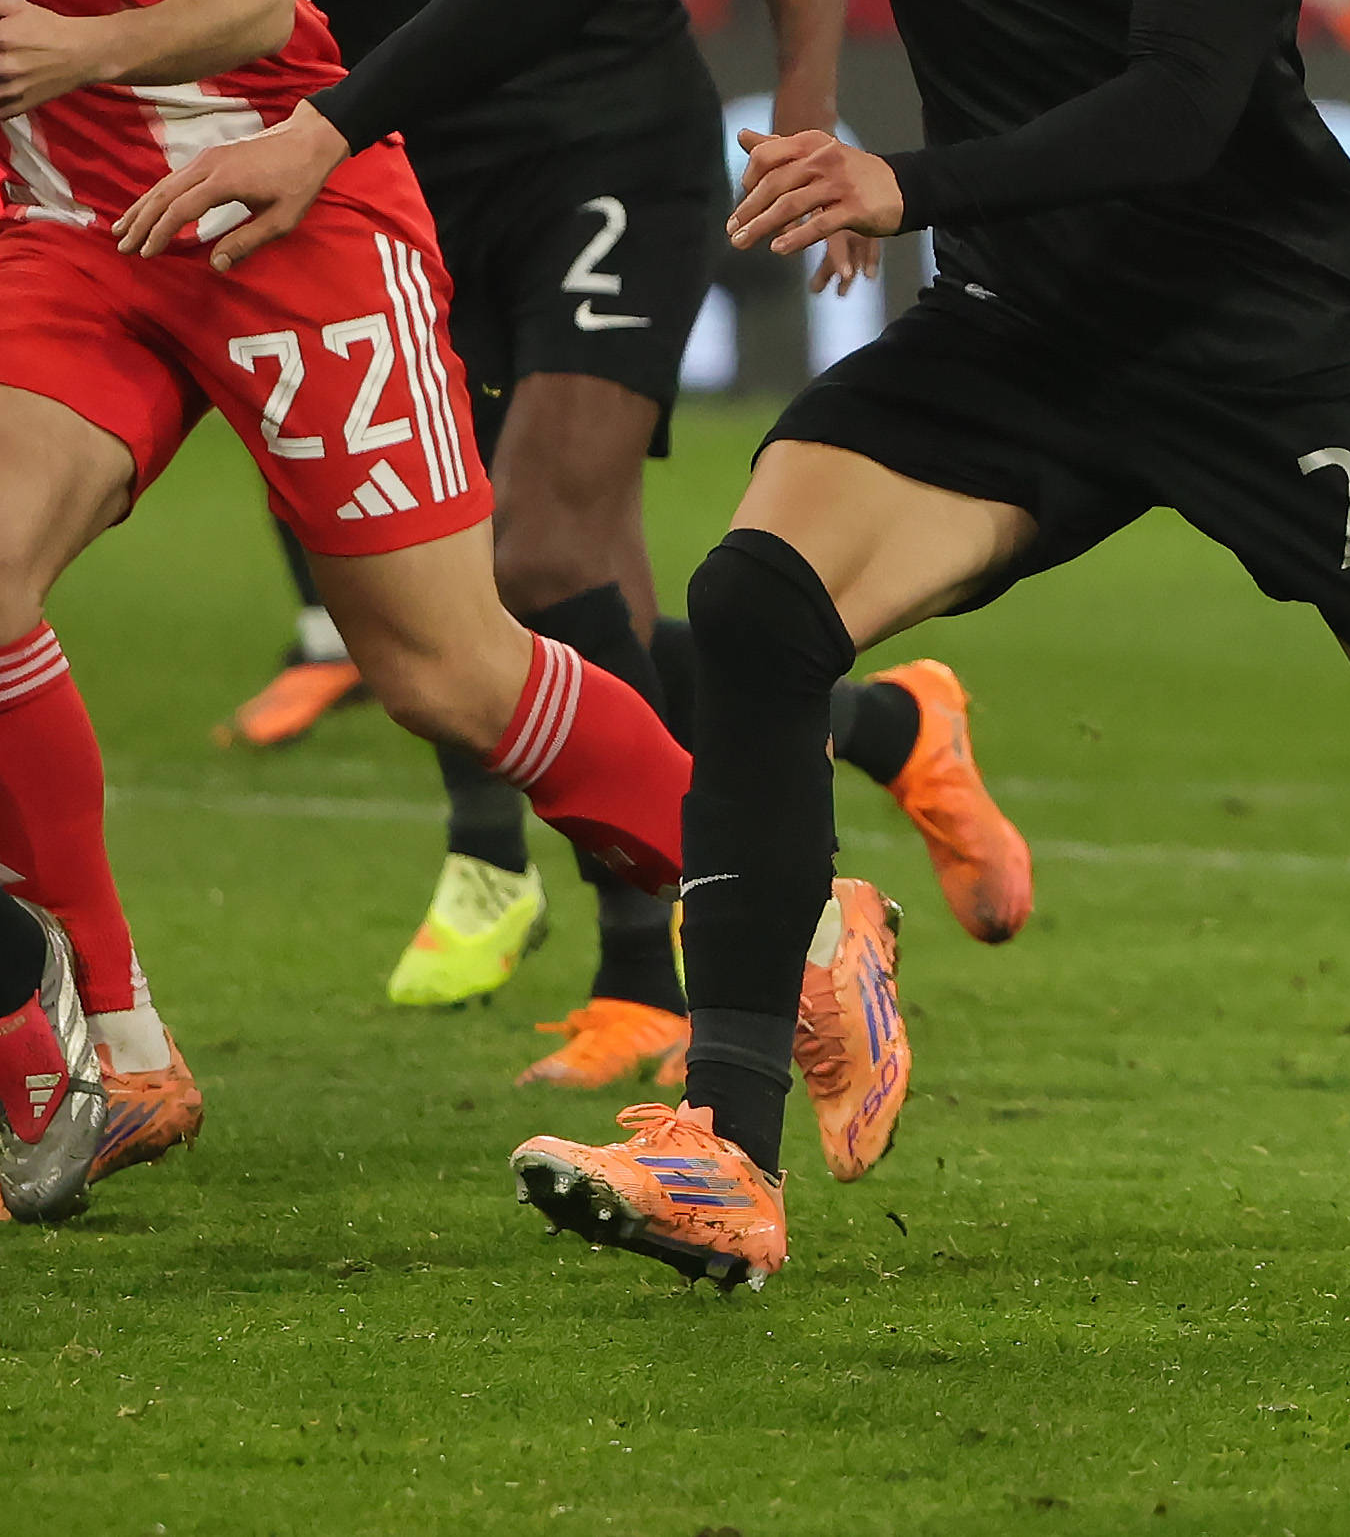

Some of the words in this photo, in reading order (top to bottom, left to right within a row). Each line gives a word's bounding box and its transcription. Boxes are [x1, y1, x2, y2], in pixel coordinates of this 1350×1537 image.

[561, 195, 627, 295] 2
[228, 312, 414, 460] 22
[845, 1051, 898, 1158] F50
